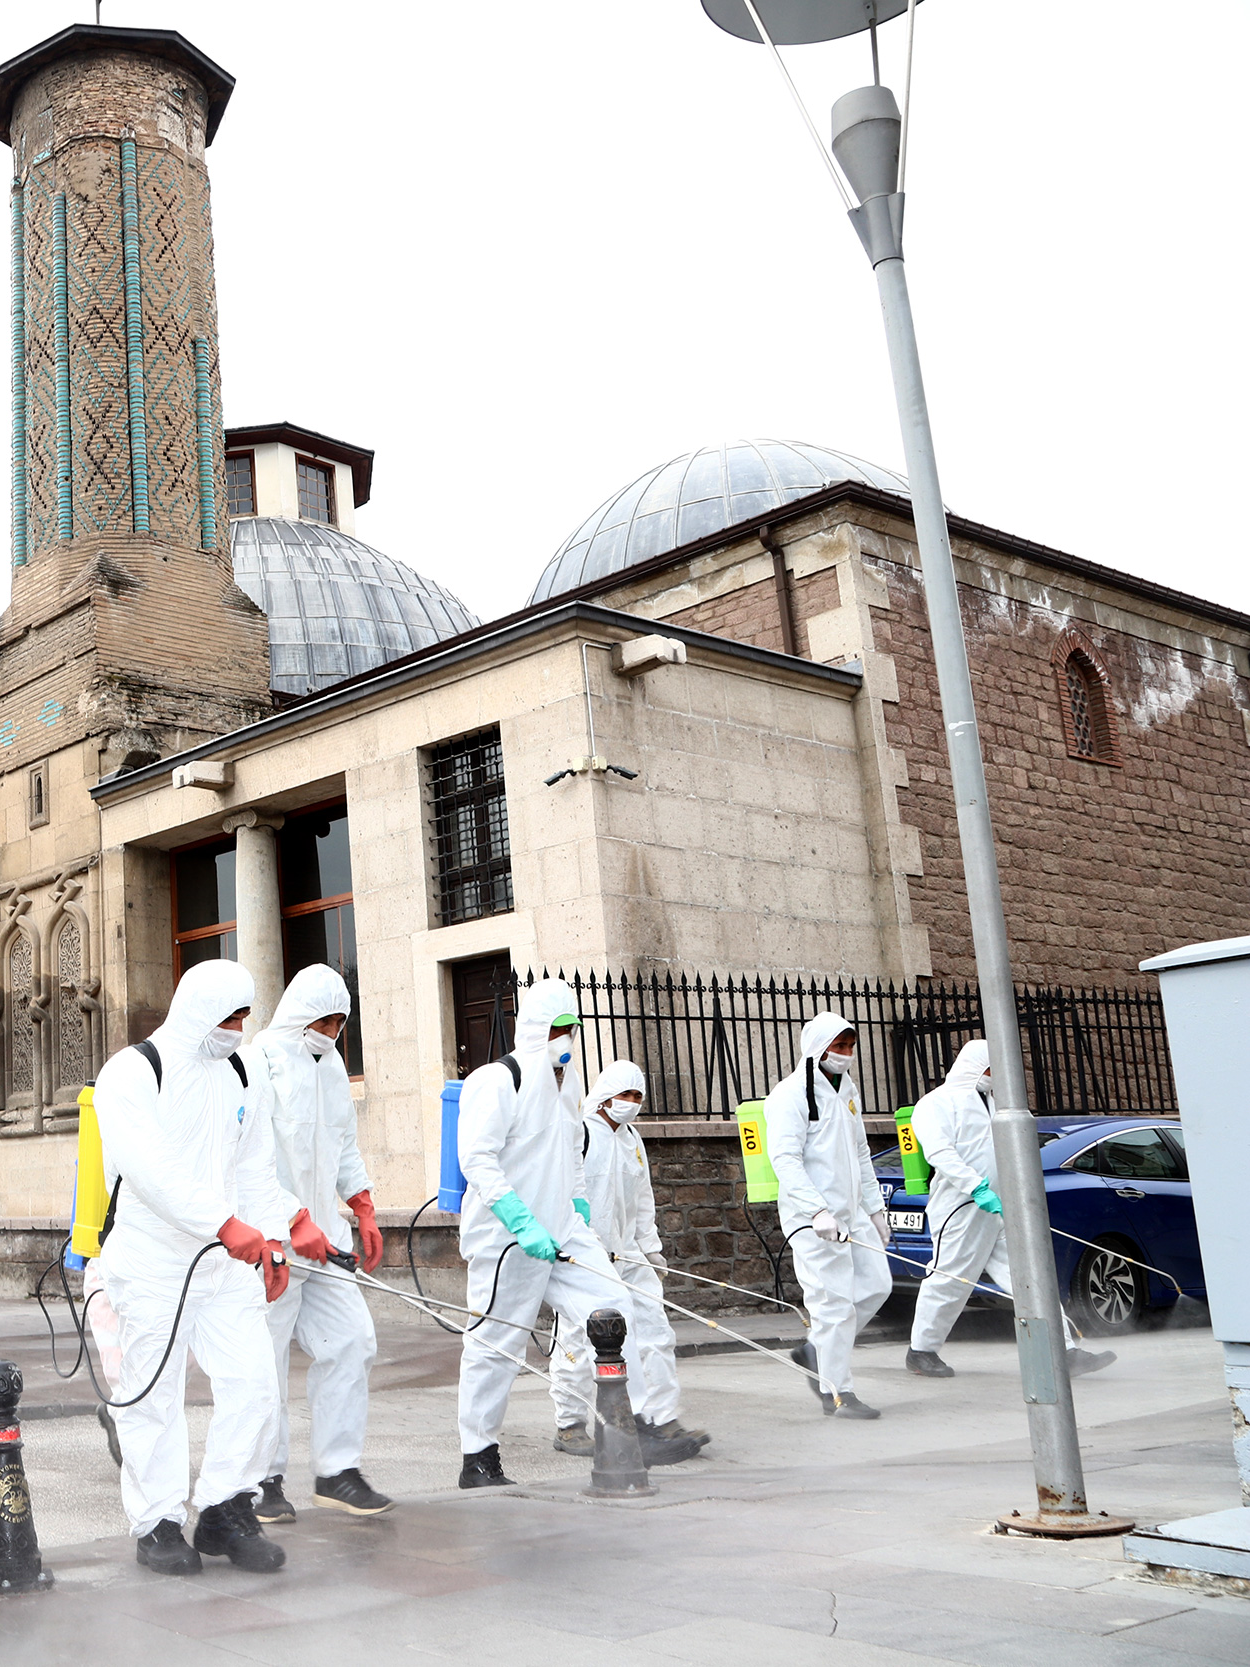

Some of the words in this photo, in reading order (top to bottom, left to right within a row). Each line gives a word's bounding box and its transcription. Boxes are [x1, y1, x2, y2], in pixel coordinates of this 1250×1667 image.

[743, 1127, 757, 1150] 017
[901, 1127, 913, 1151] 024
[903, 1213, 921, 1227] 491
